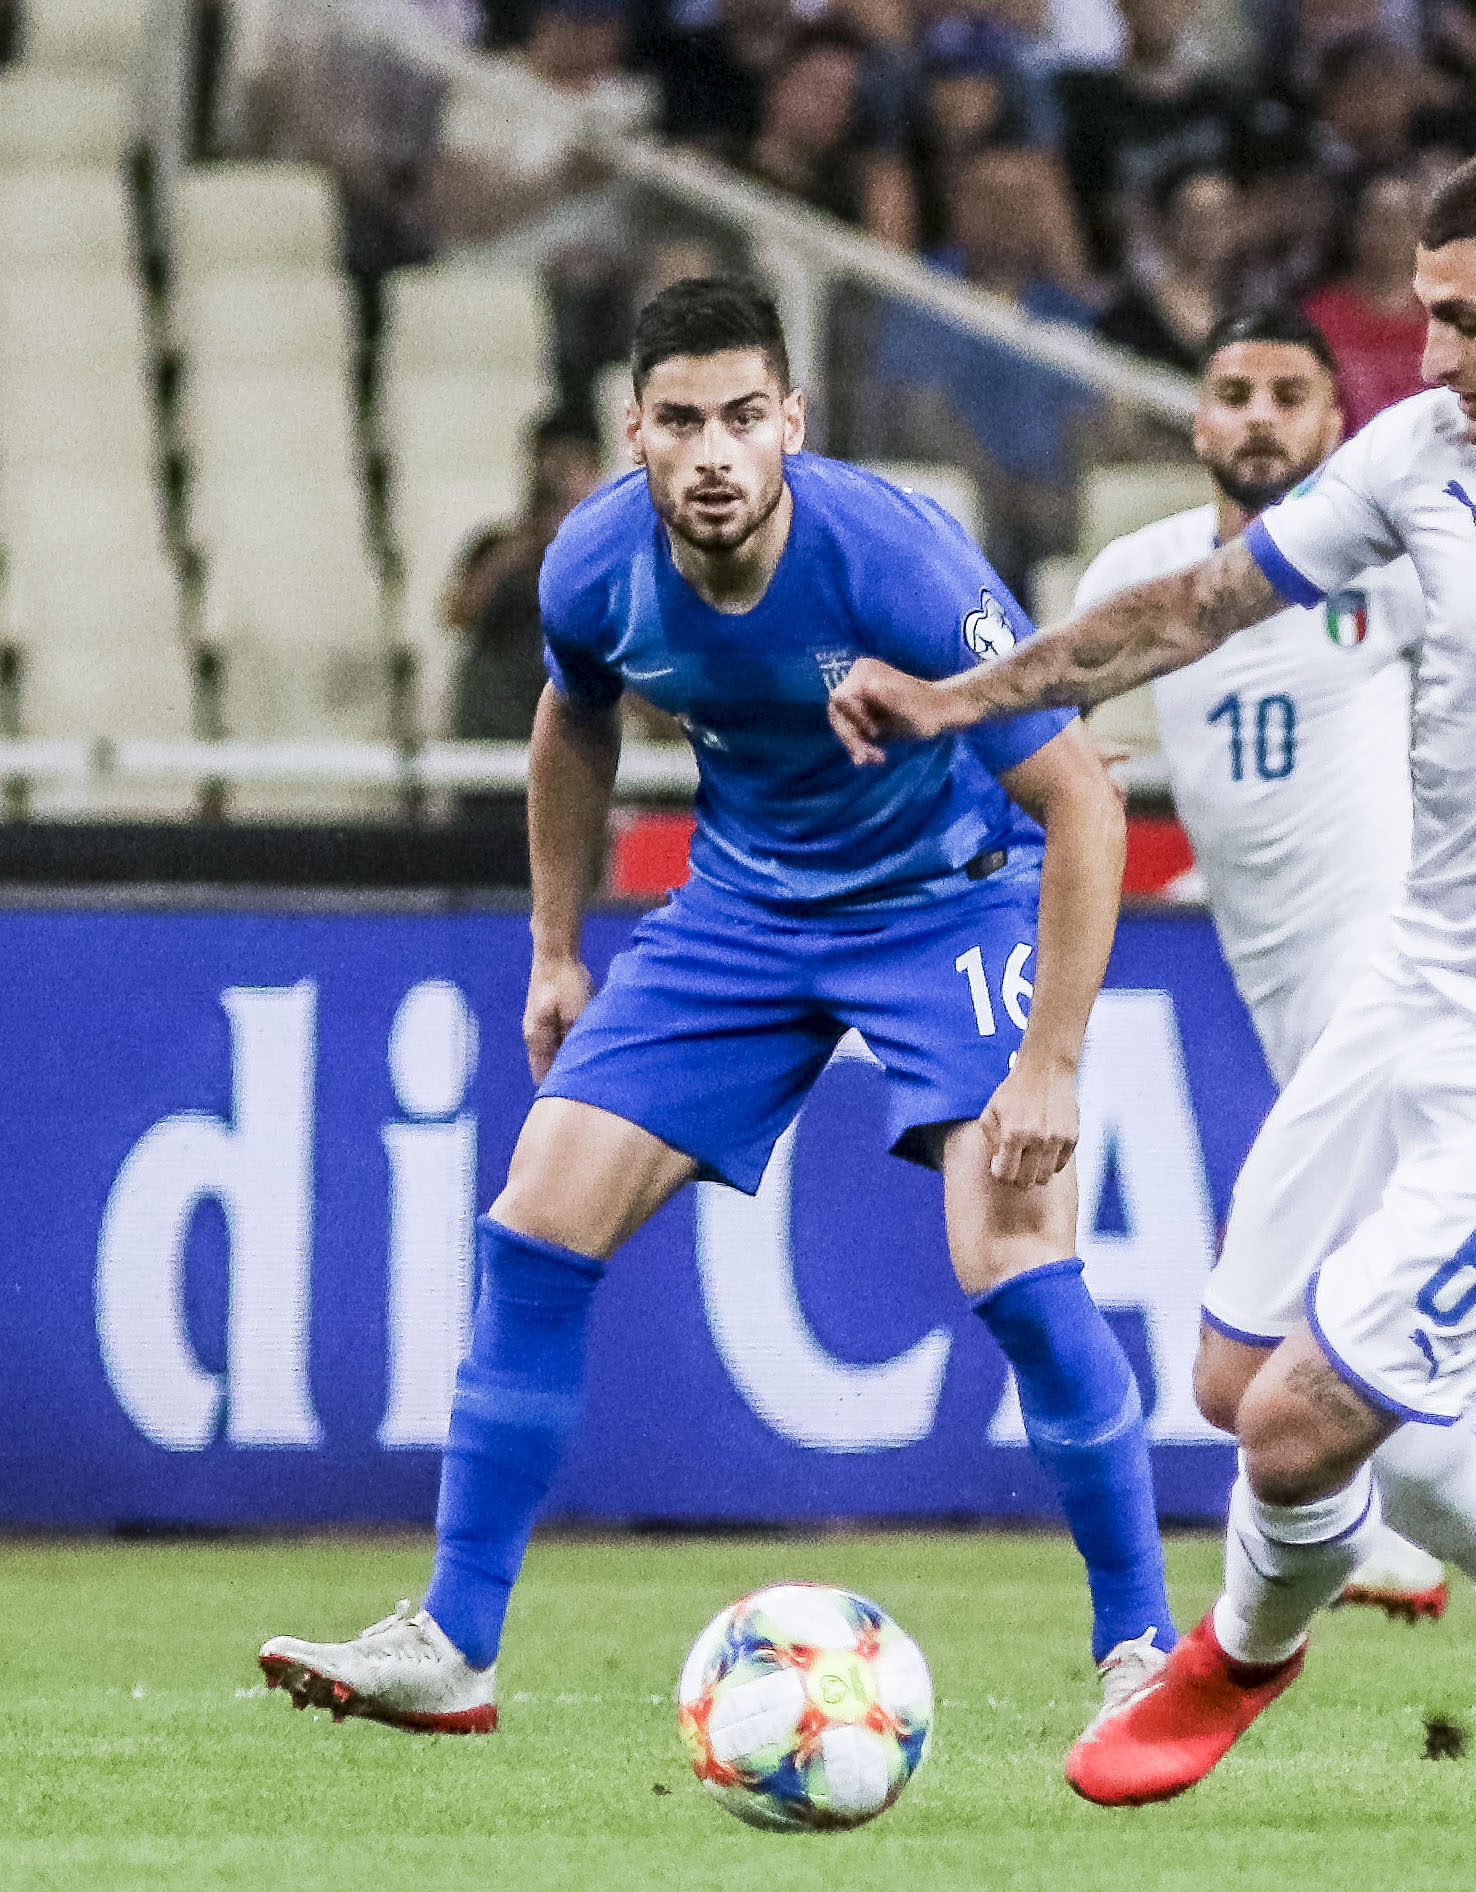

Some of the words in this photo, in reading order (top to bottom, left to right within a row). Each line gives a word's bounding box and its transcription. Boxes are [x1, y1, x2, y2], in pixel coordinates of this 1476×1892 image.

[1205, 692, 1297, 781] 10
[955, 942, 1034, 1036] 16
[94, 977, 481, 1453] di
